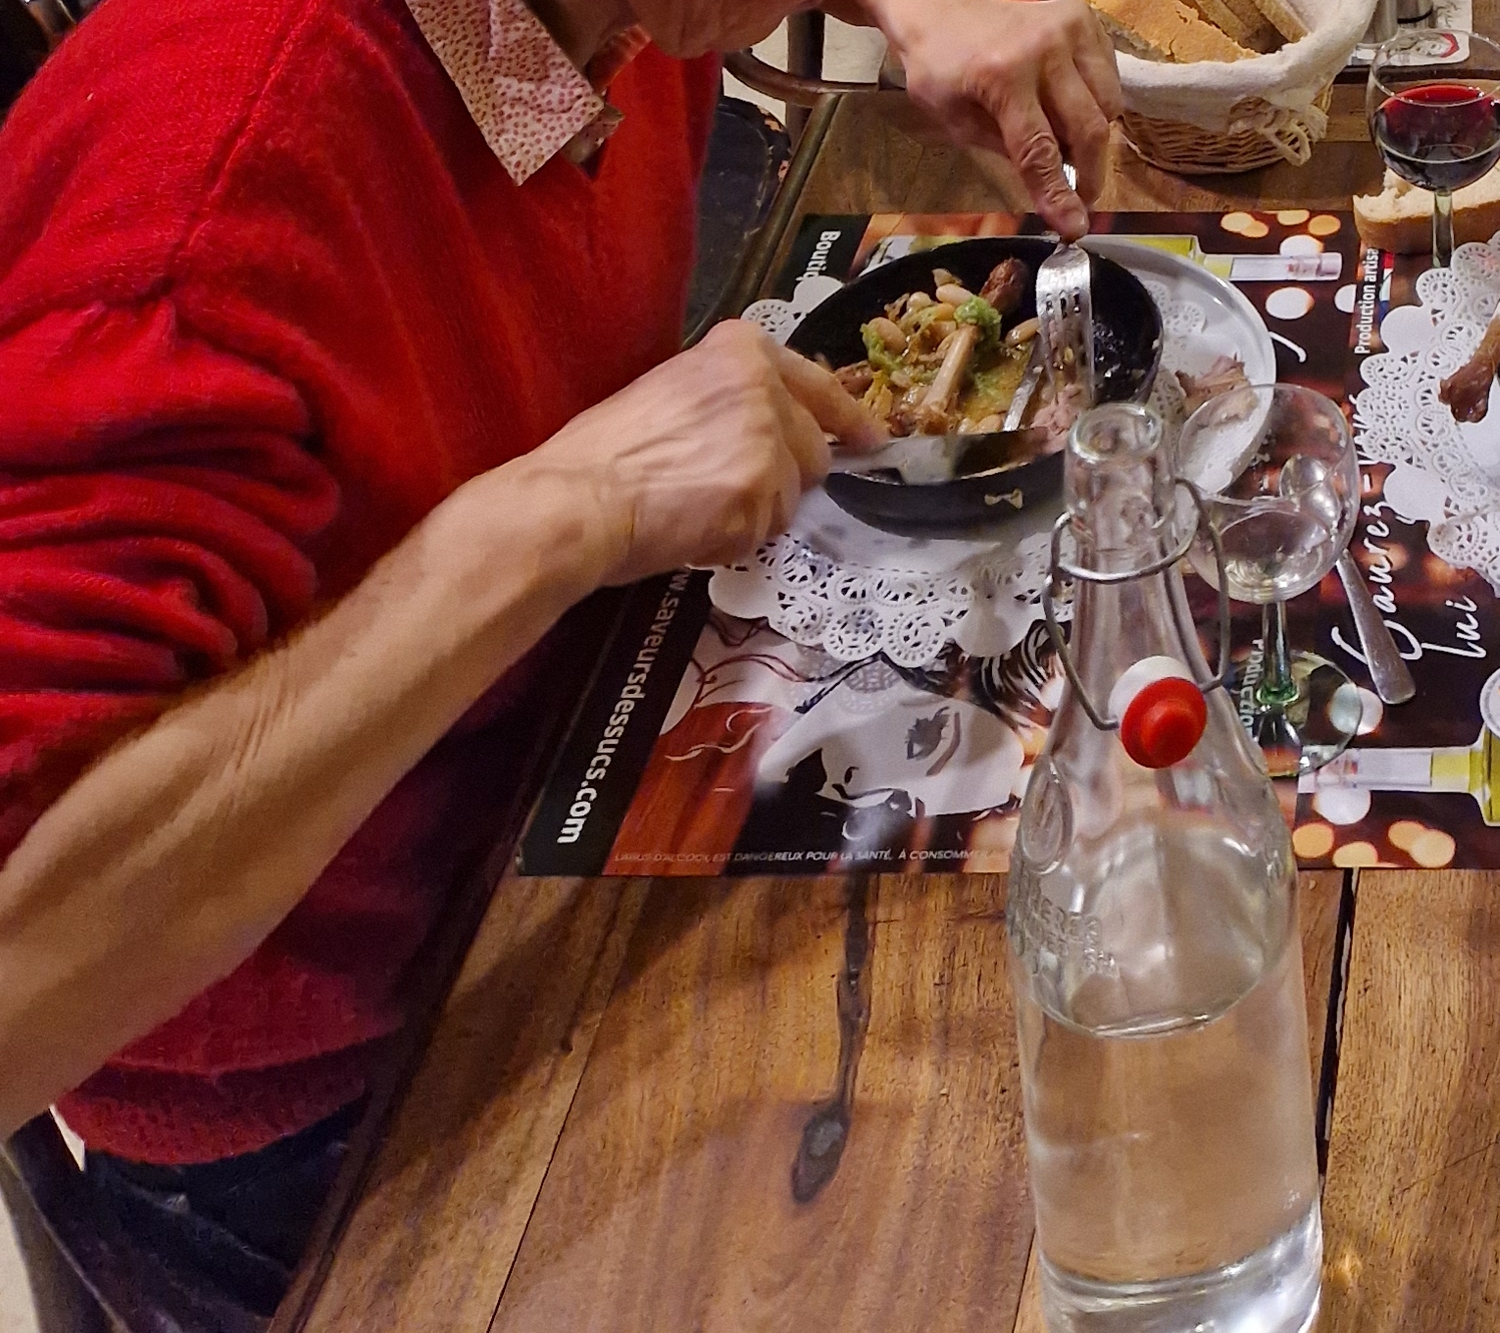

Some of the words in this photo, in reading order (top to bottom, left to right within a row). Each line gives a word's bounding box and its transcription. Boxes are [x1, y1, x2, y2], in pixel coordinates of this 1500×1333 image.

[1354, 285, 1377, 354] Production
[556, 570, 692, 845] w.saveursdessucs.com
[805, 850, 839, 861] POUR
